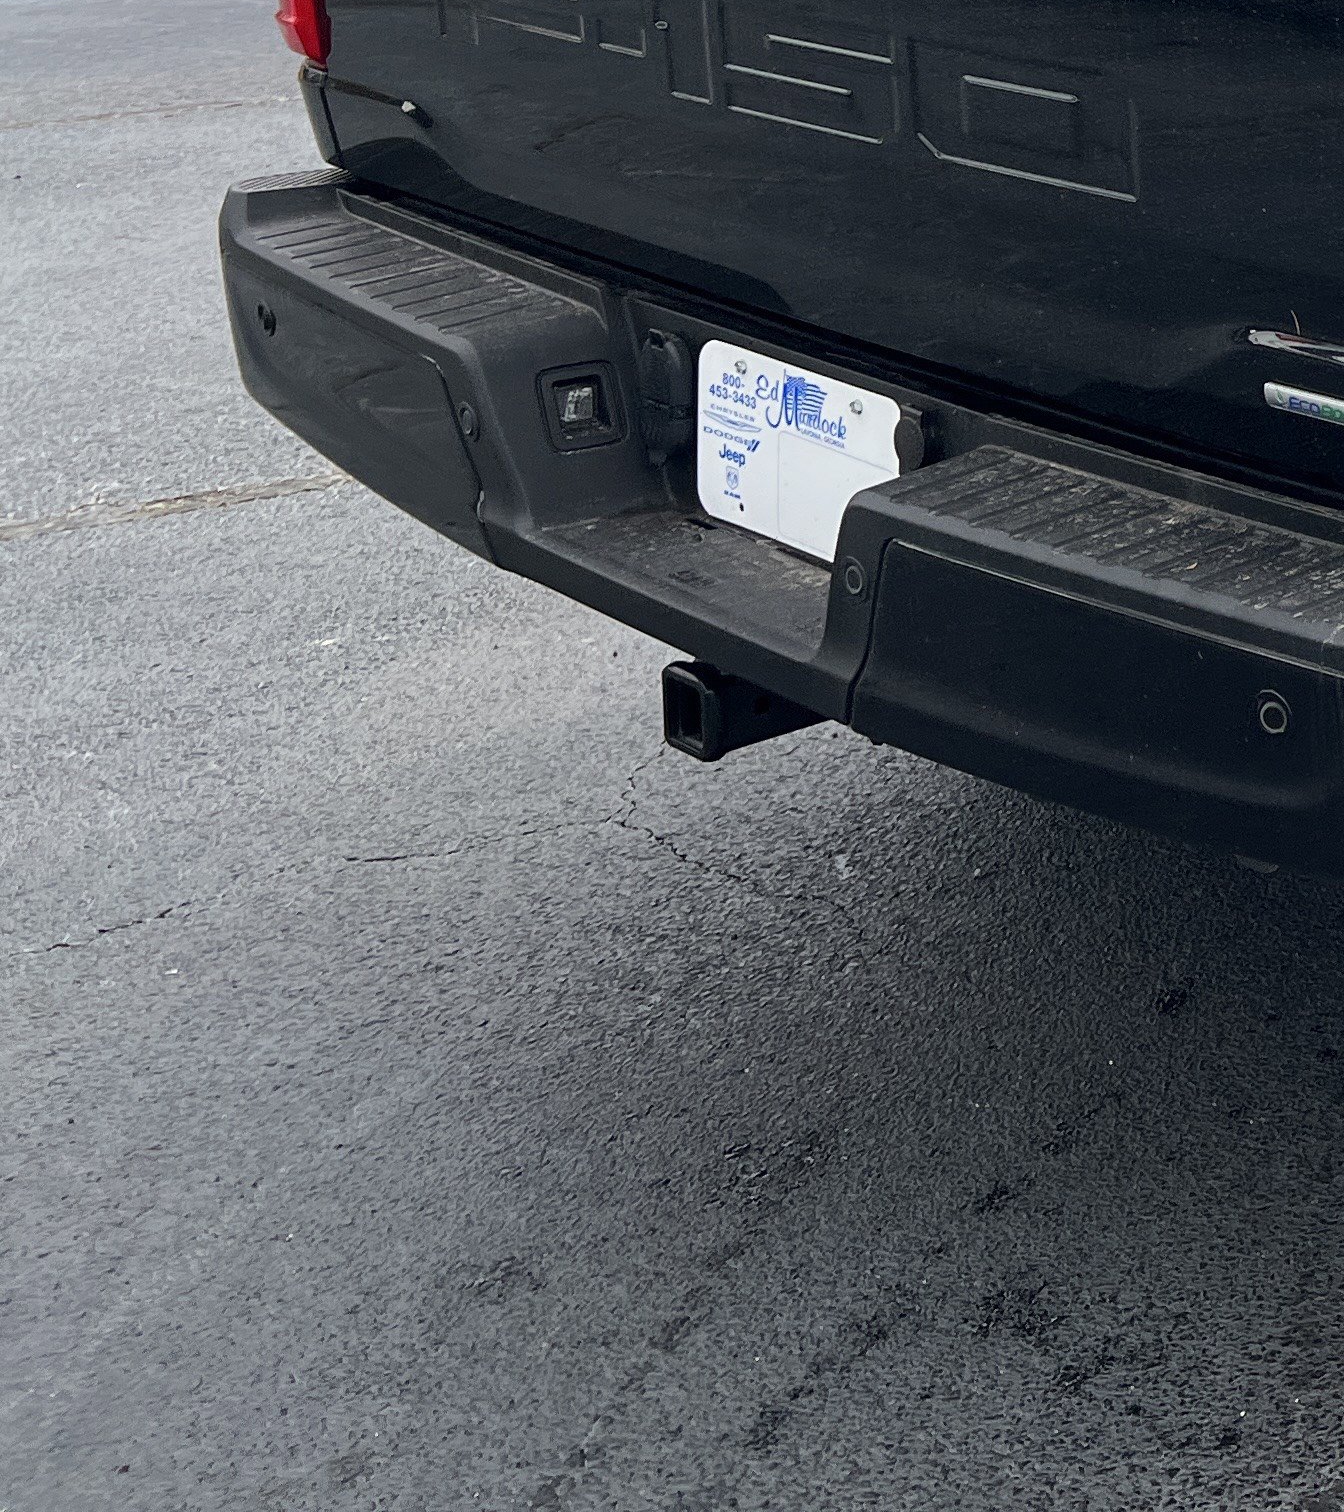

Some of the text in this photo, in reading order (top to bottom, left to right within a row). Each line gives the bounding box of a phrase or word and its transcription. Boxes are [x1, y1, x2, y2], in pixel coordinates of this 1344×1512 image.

[722, 372, 746, 389] 800-
[755, 374, 780, 403] Ed
[709, 383, 757, 410] 453-3433
[710, 403, 755, 423] CHRYSLER
[718, 443, 746, 467] Jeep
